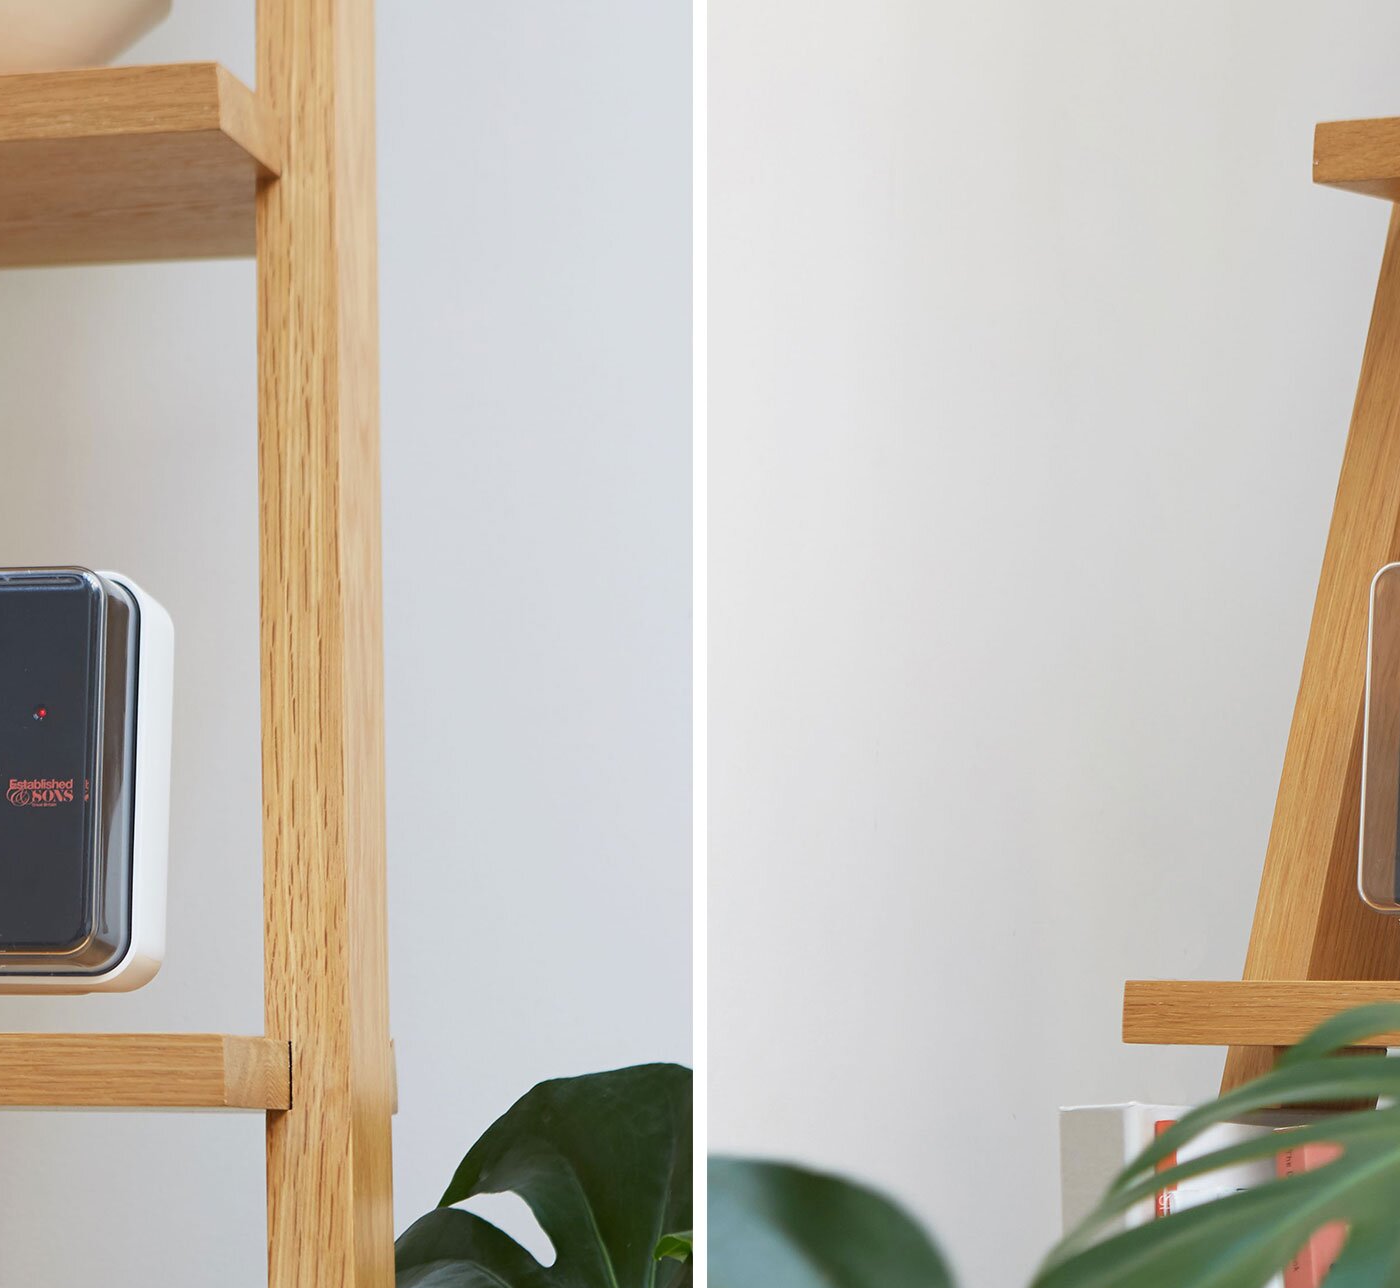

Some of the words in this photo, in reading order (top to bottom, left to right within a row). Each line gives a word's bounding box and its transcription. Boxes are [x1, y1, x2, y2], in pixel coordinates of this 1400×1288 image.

[9, 778, 74, 789] Established
[6, 787, 32, 807] &
[32, 789, 74, 802] SONS
